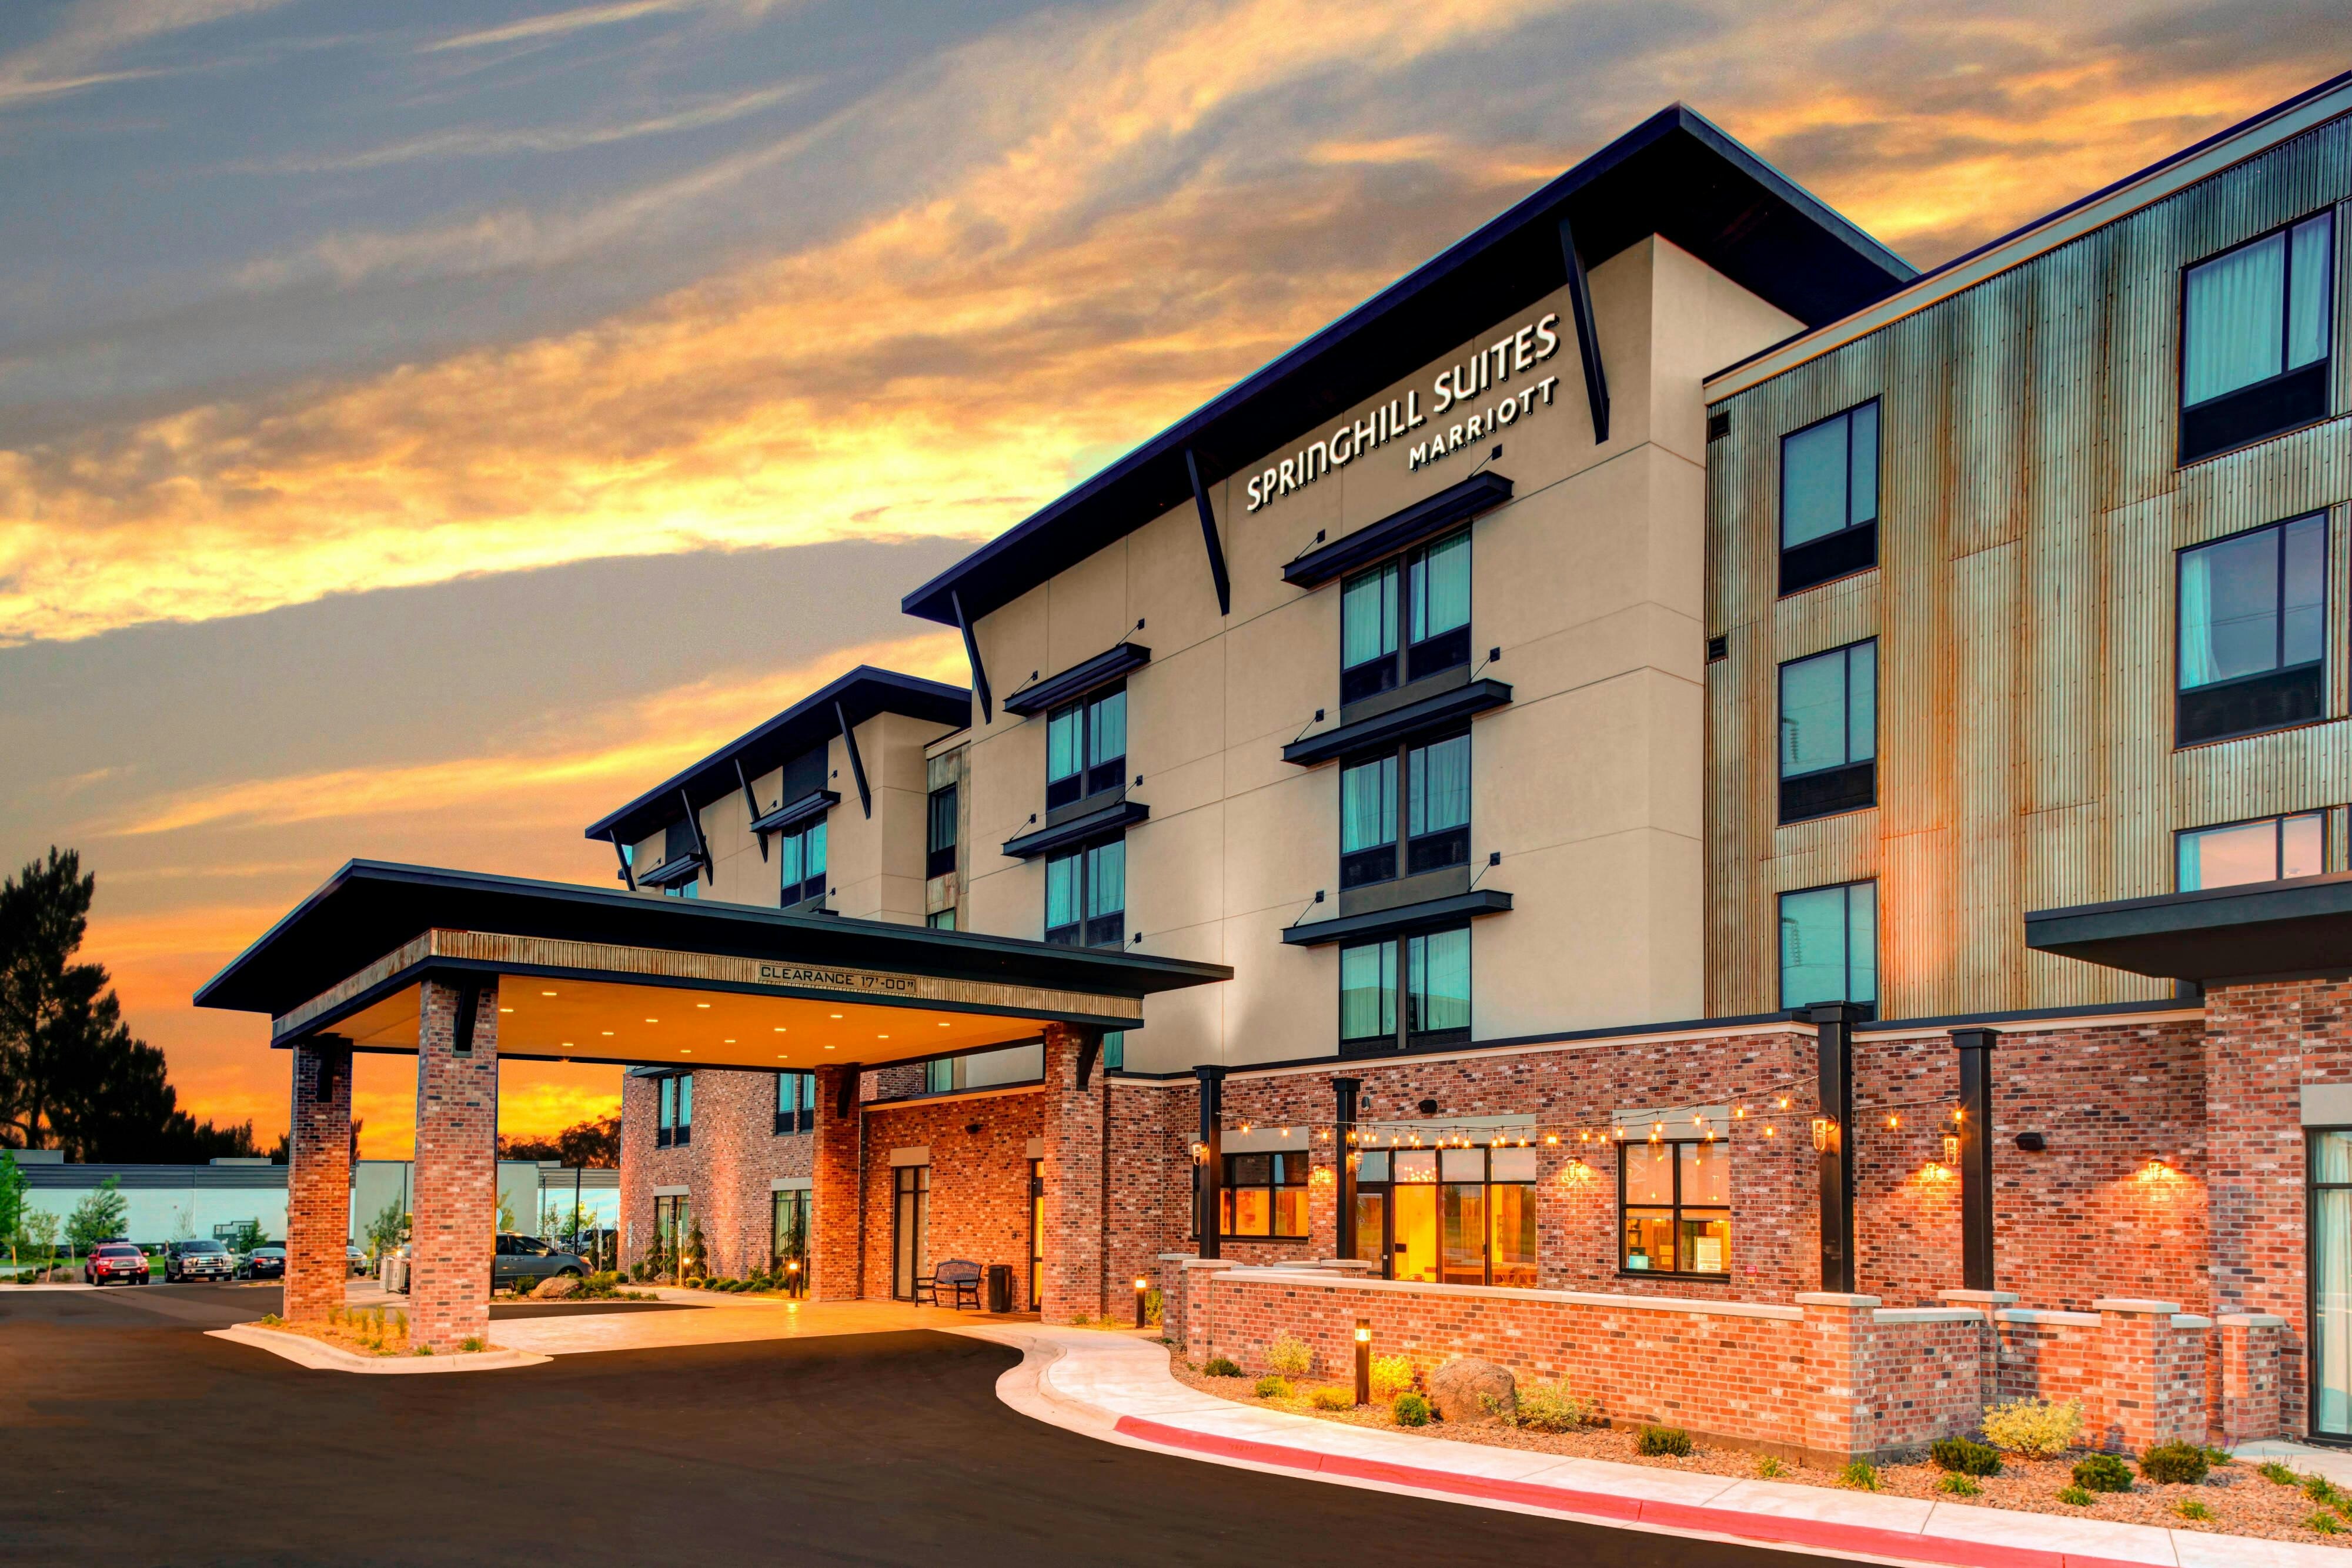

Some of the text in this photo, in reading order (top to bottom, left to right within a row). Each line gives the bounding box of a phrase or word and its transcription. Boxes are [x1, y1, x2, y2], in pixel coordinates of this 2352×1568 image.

[1247, 313, 1559, 511] SPRINGHILL SUITES
[1409, 376, 1558, 471] MARRIOTT
[761, 966, 854, 985] CLEARANCE
